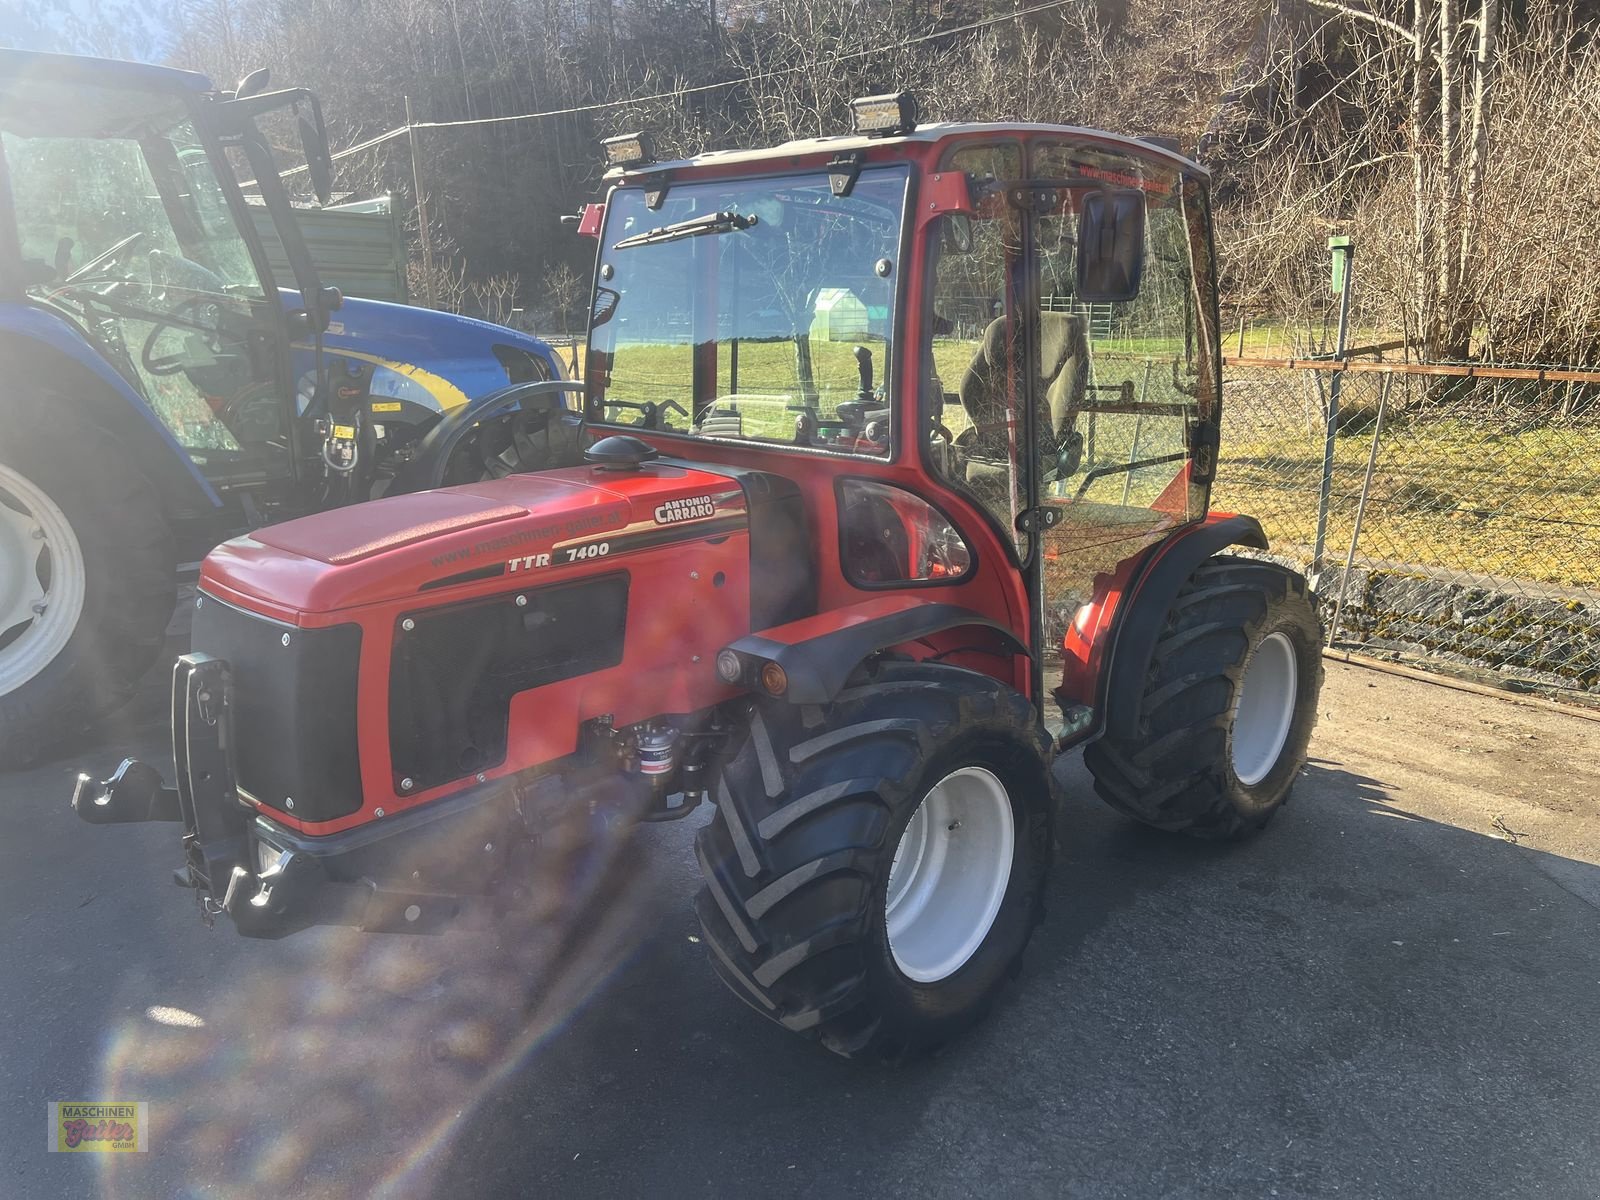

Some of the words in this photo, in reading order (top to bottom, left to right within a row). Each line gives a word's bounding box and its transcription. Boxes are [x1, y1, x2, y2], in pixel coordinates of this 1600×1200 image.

[664, 495, 711, 510] ANTONIO
[654, 503, 714, 523] CARRARO
[508, 553, 550, 572] TTR
[566, 542, 610, 562] 7400
